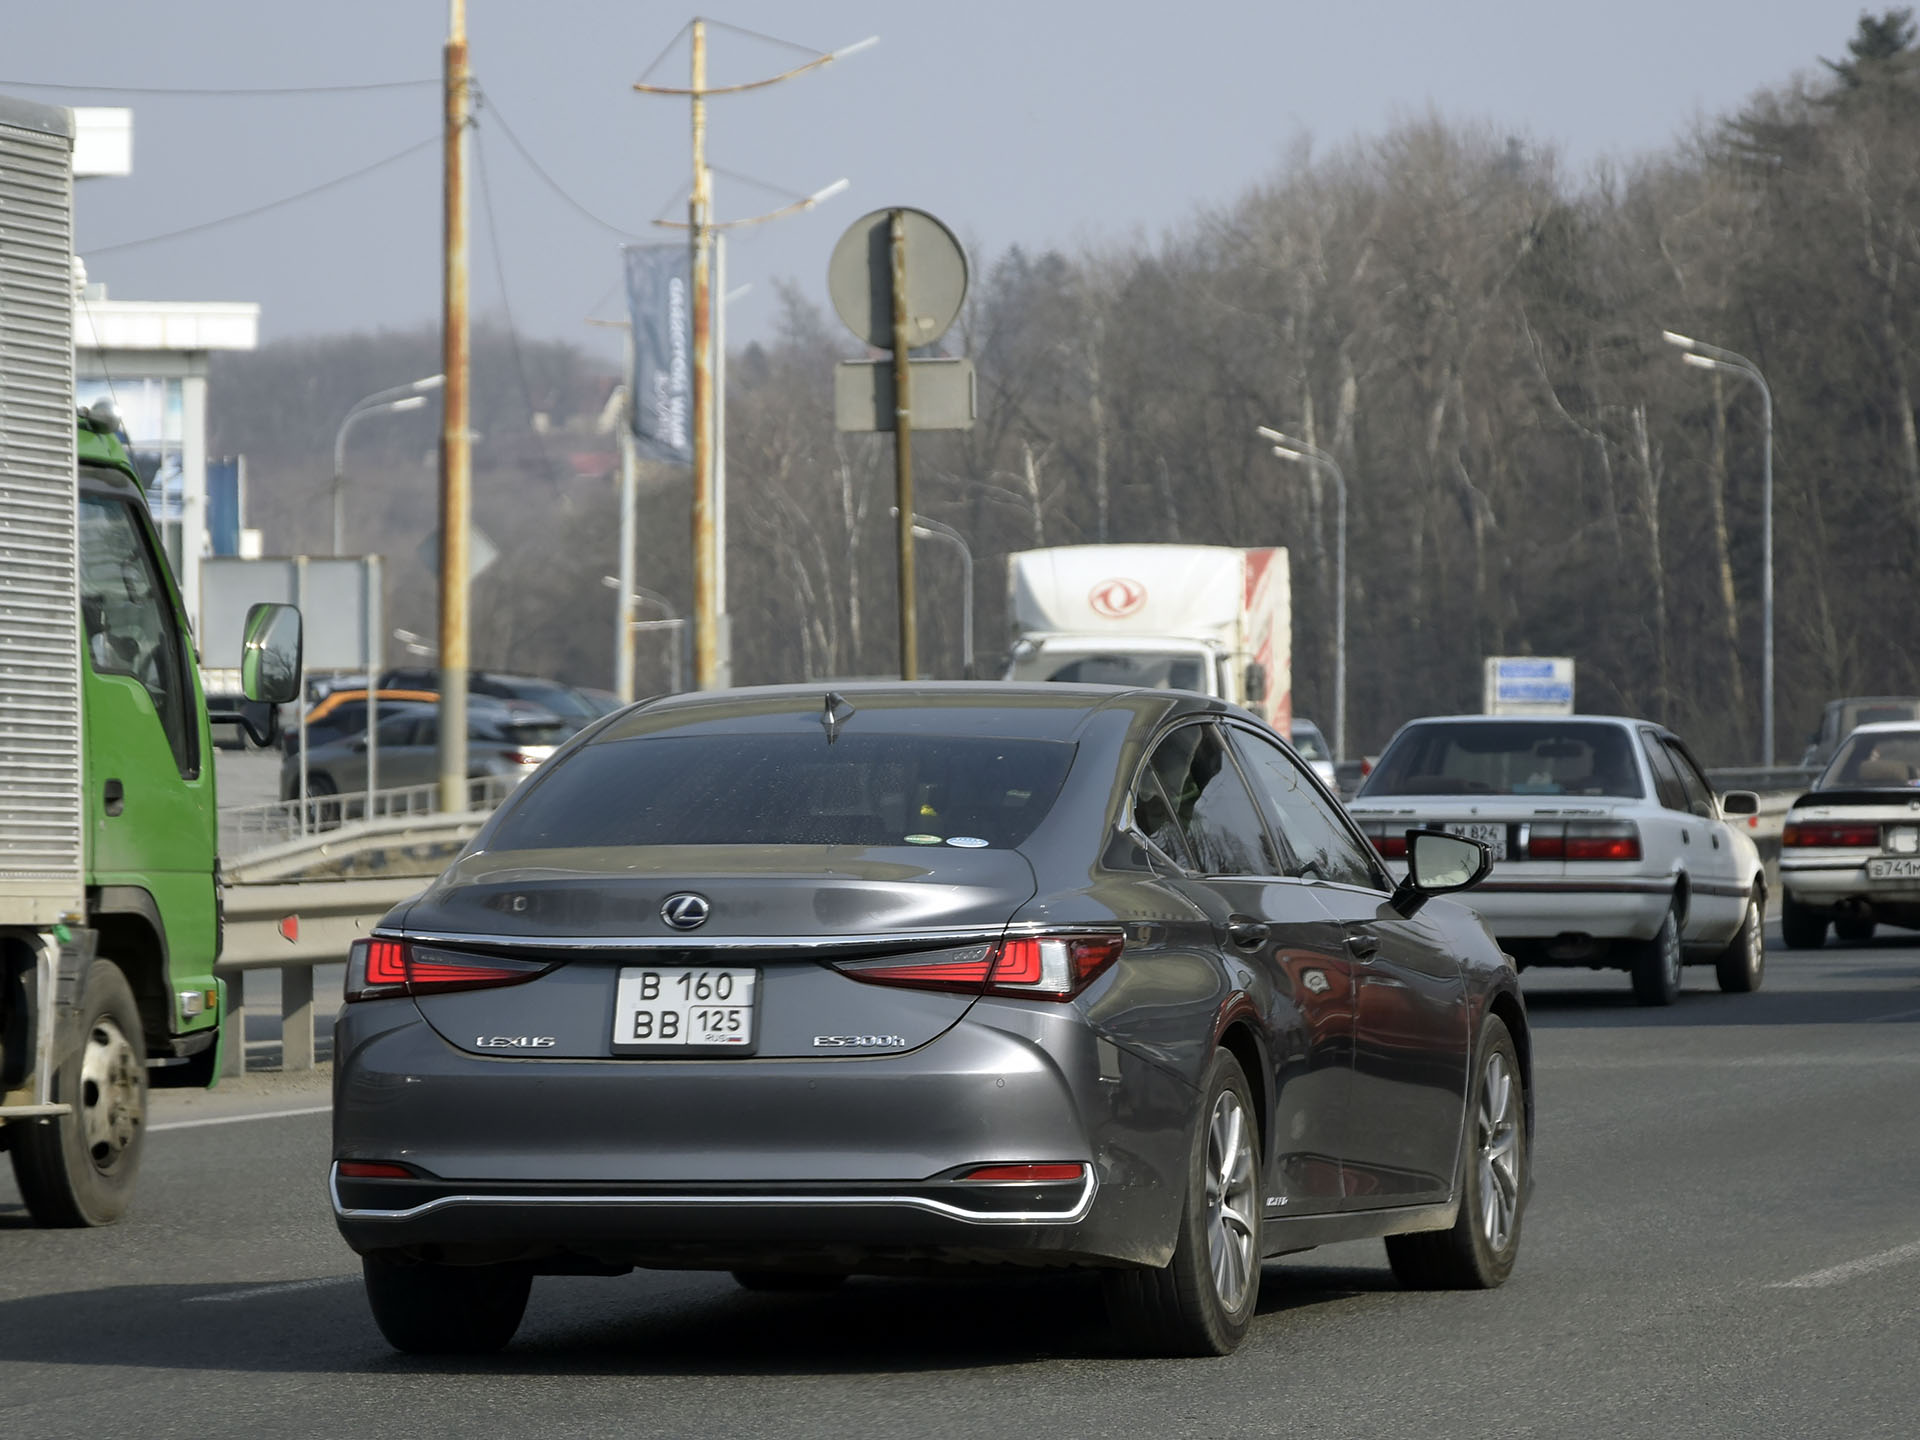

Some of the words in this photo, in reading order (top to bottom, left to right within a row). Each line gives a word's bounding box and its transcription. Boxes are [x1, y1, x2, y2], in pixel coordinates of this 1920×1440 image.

[677, 971, 733, 1001] 160
[697, 1009, 741, 1032] 125
[476, 1035, 556, 1048] LEXUS
[813, 1035, 905, 1047] ES300h
